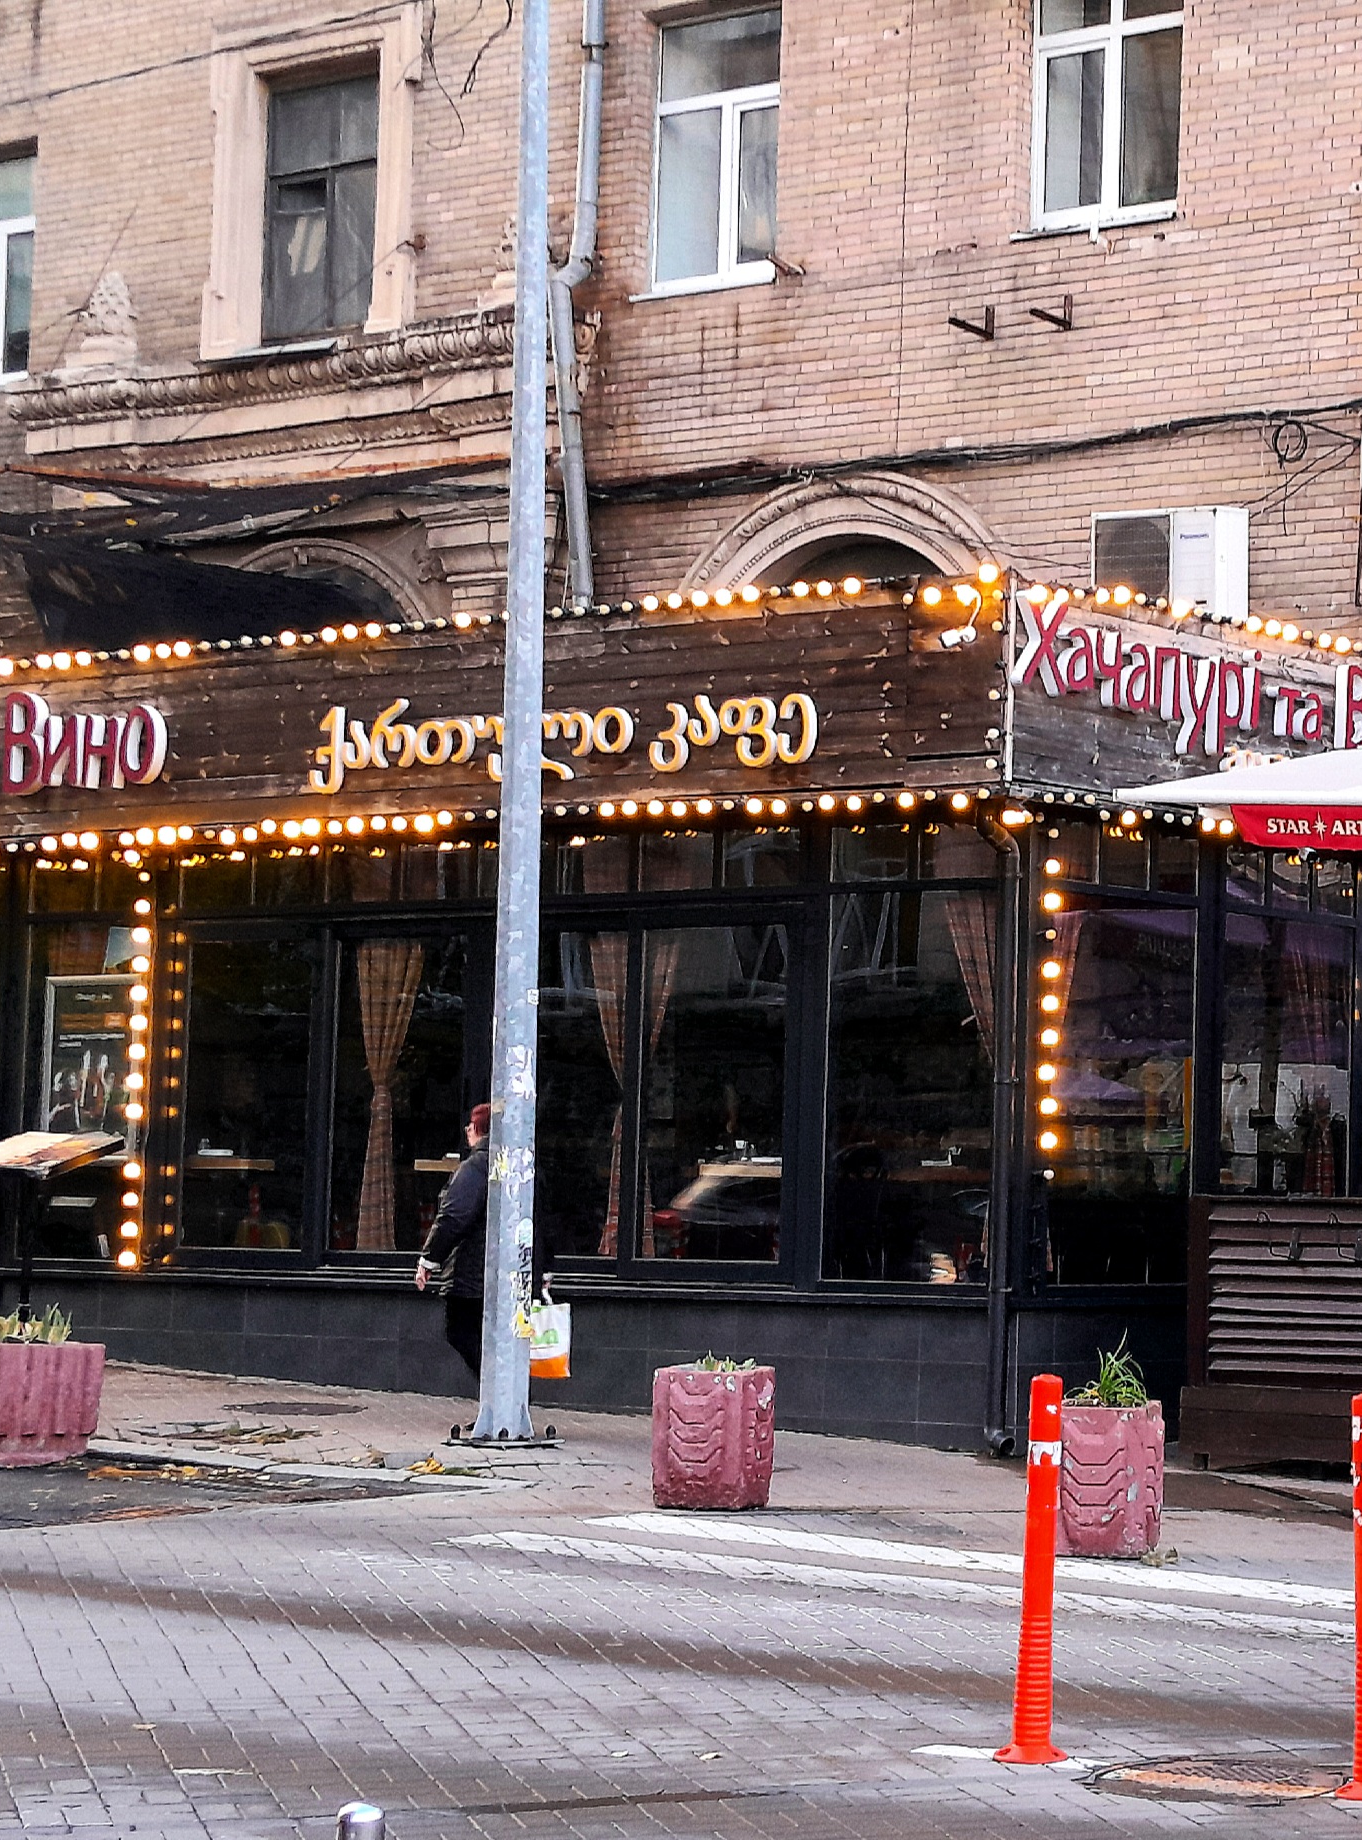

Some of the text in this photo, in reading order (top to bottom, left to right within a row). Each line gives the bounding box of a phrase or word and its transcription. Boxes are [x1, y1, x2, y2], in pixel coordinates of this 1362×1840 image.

[1010, 588, 1261, 756] Хачапурі
[1266, 686, 1323, 741] та
[3, 691, 169, 796] Вино
[648, 692, 819, 773] კაფე
[1267, 817, 1312, 835] STAR
